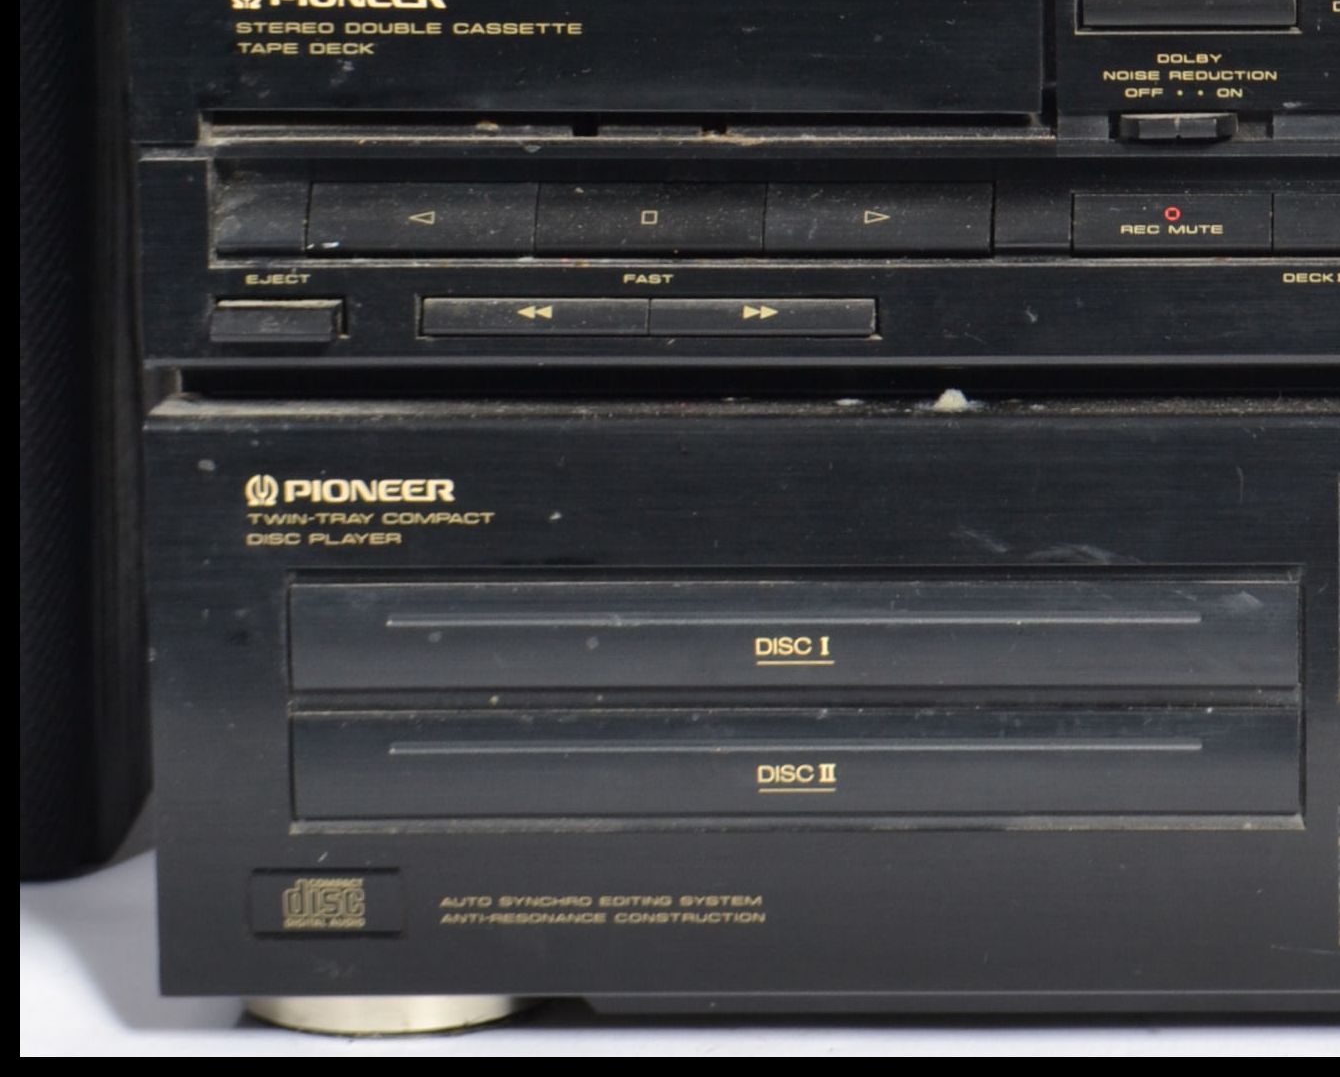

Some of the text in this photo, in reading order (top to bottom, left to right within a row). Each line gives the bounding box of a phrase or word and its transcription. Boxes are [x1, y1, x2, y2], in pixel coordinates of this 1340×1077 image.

[236, 22, 582, 34] STEREO DOUBLE CASSETTE
[238, 43, 374, 54] TAPE DECK
[1157, 54, 1221, 63] DOLBY
[1103, 71, 1277, 80] NOISE REDUCTION
[1125, 88, 1163, 97] OFF
[1217, 88, 1242, 98] ON
[1121, 225, 1223, 234] REC MUTE
[245, 274, 311, 284] EJECT
[624, 274, 673, 284] FAST
[1283, 273, 1333, 283] DECK
[285, 479, 454, 502] PIONEER
[247, 512, 494, 525] TWIN-TRAY COMPACT
[246, 533, 401, 545] DISC PLAYER
[756, 637, 812, 655] DISC
[758, 765, 814, 783] DISC
[440, 896, 762, 907] AUTO SYNCHRO EDITING SYSTEM
[441, 912, 765, 924] ANTI-RESONANCE CONSTRUCTION
